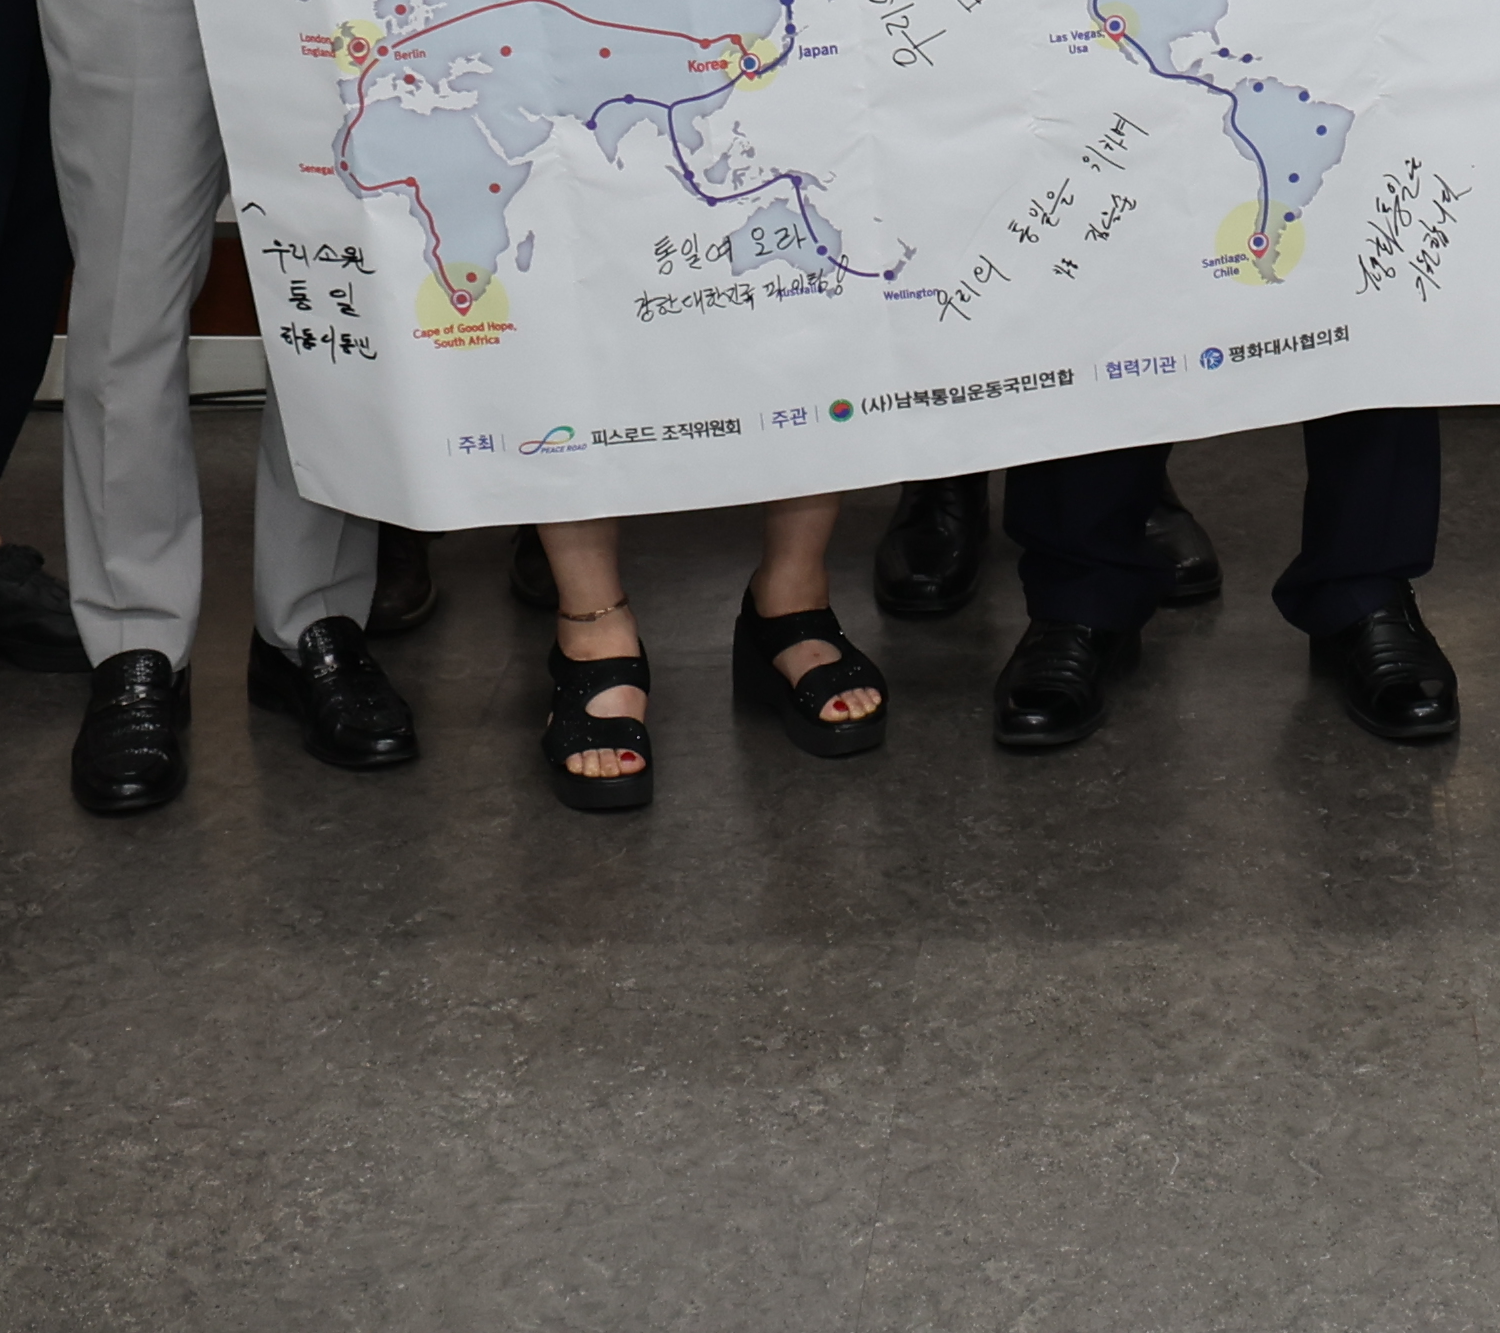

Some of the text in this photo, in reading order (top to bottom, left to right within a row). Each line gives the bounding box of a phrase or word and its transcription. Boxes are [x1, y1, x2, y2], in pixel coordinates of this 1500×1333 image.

[1049, 31, 1069, 44] Las
[301, 45, 336, 59] England
[394, 48, 427, 61] Berlin
[798, 41, 839, 61] Japan
[1068, 42, 1090, 55] Usa
[687, 55, 729, 74] Korea
[299, 163, 336, 177] Senegal
[1212, 263, 1241, 279] Chile
[883, 284, 939, 302] Wellington
[413, 319, 518, 340] Cape of Good Hope,
[433, 333, 501, 350] South Africa
[1228, 324, 1351, 364] 평화대사협의회
[1105, 355, 1177, 381] 협력기관
[860, 368, 1075, 417] (사)남북통일운동국민연합
[769, 407, 808, 430] 주관
[591, 416, 742, 447] 피스로드 조직위원회
[458, 434, 495, 455] 주최
[541, 441, 588, 455] PEACE ROAD
